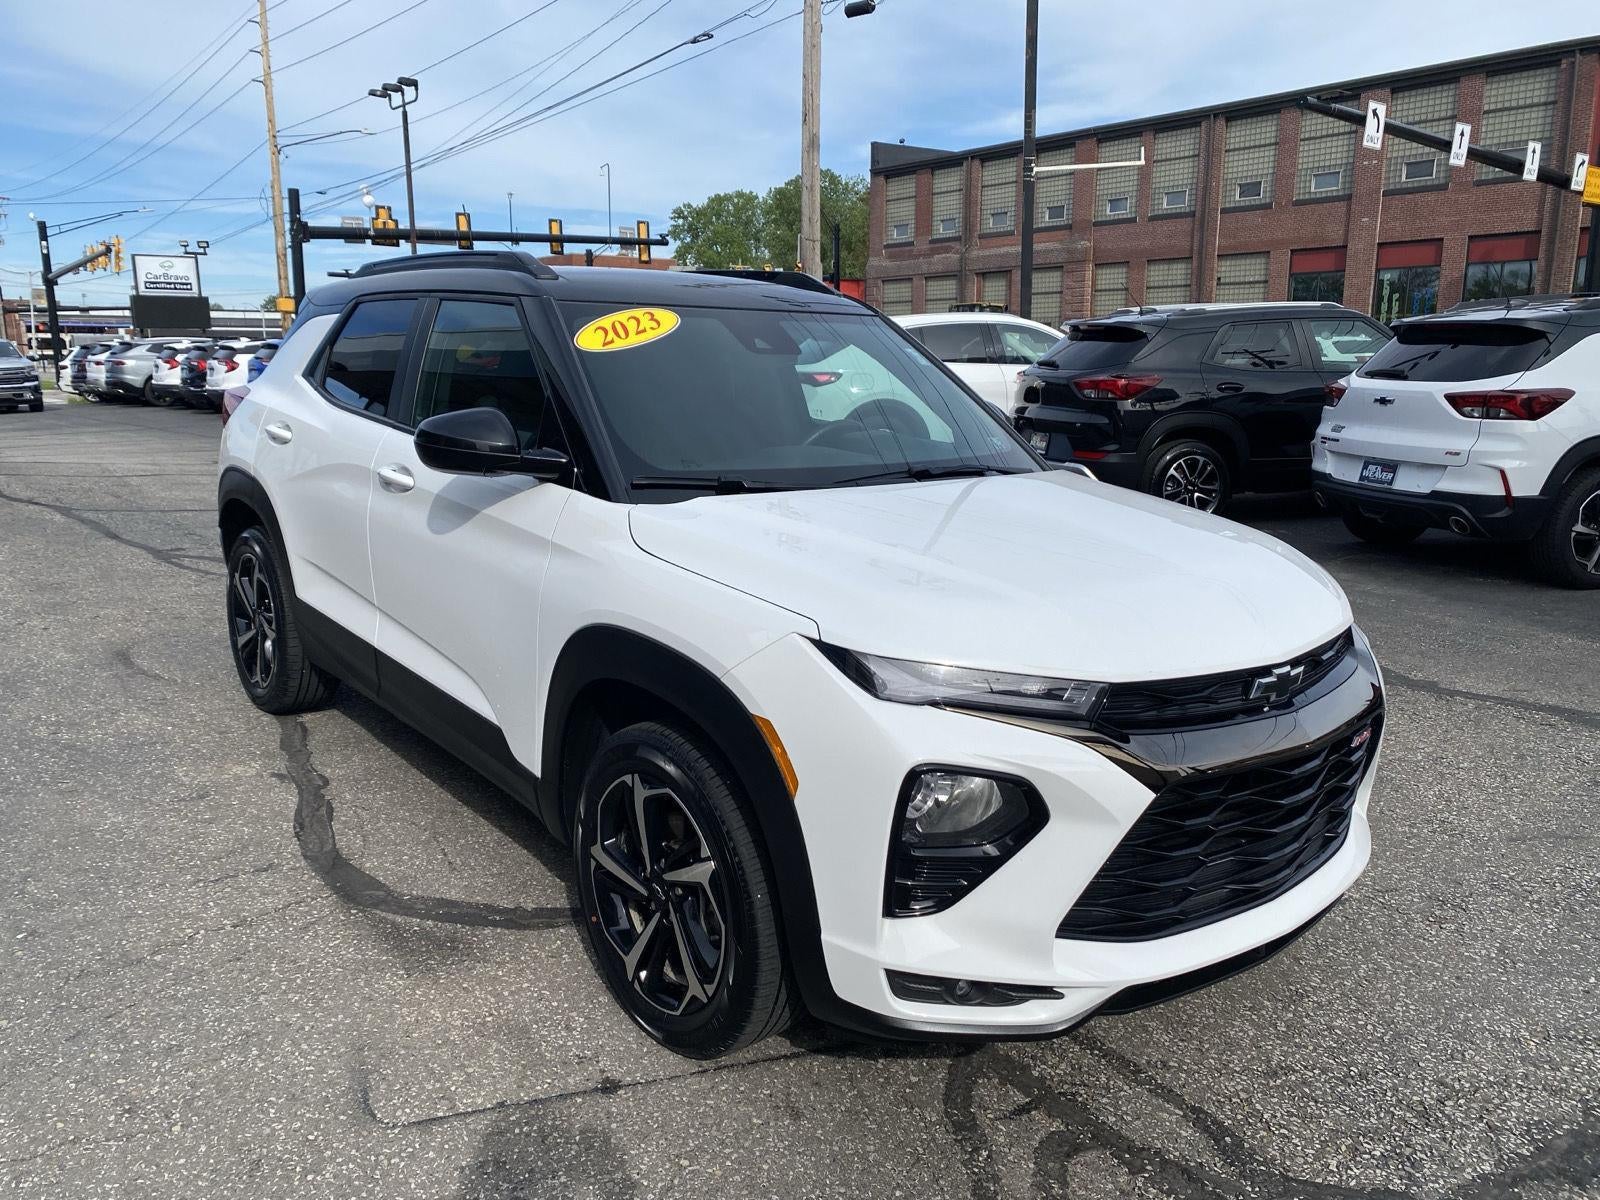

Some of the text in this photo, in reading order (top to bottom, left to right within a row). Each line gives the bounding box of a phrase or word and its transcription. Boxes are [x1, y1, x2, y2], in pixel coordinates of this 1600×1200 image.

[1365, 134, 1380, 145] ONLY
[1452, 151, 1464, 161] ONLY
[145, 271, 190, 281] CarBravo
[594, 311, 661, 347] 2023
[1367, 464, 1382, 473] RICK
[1362, 468, 1394, 480] WEAVER
